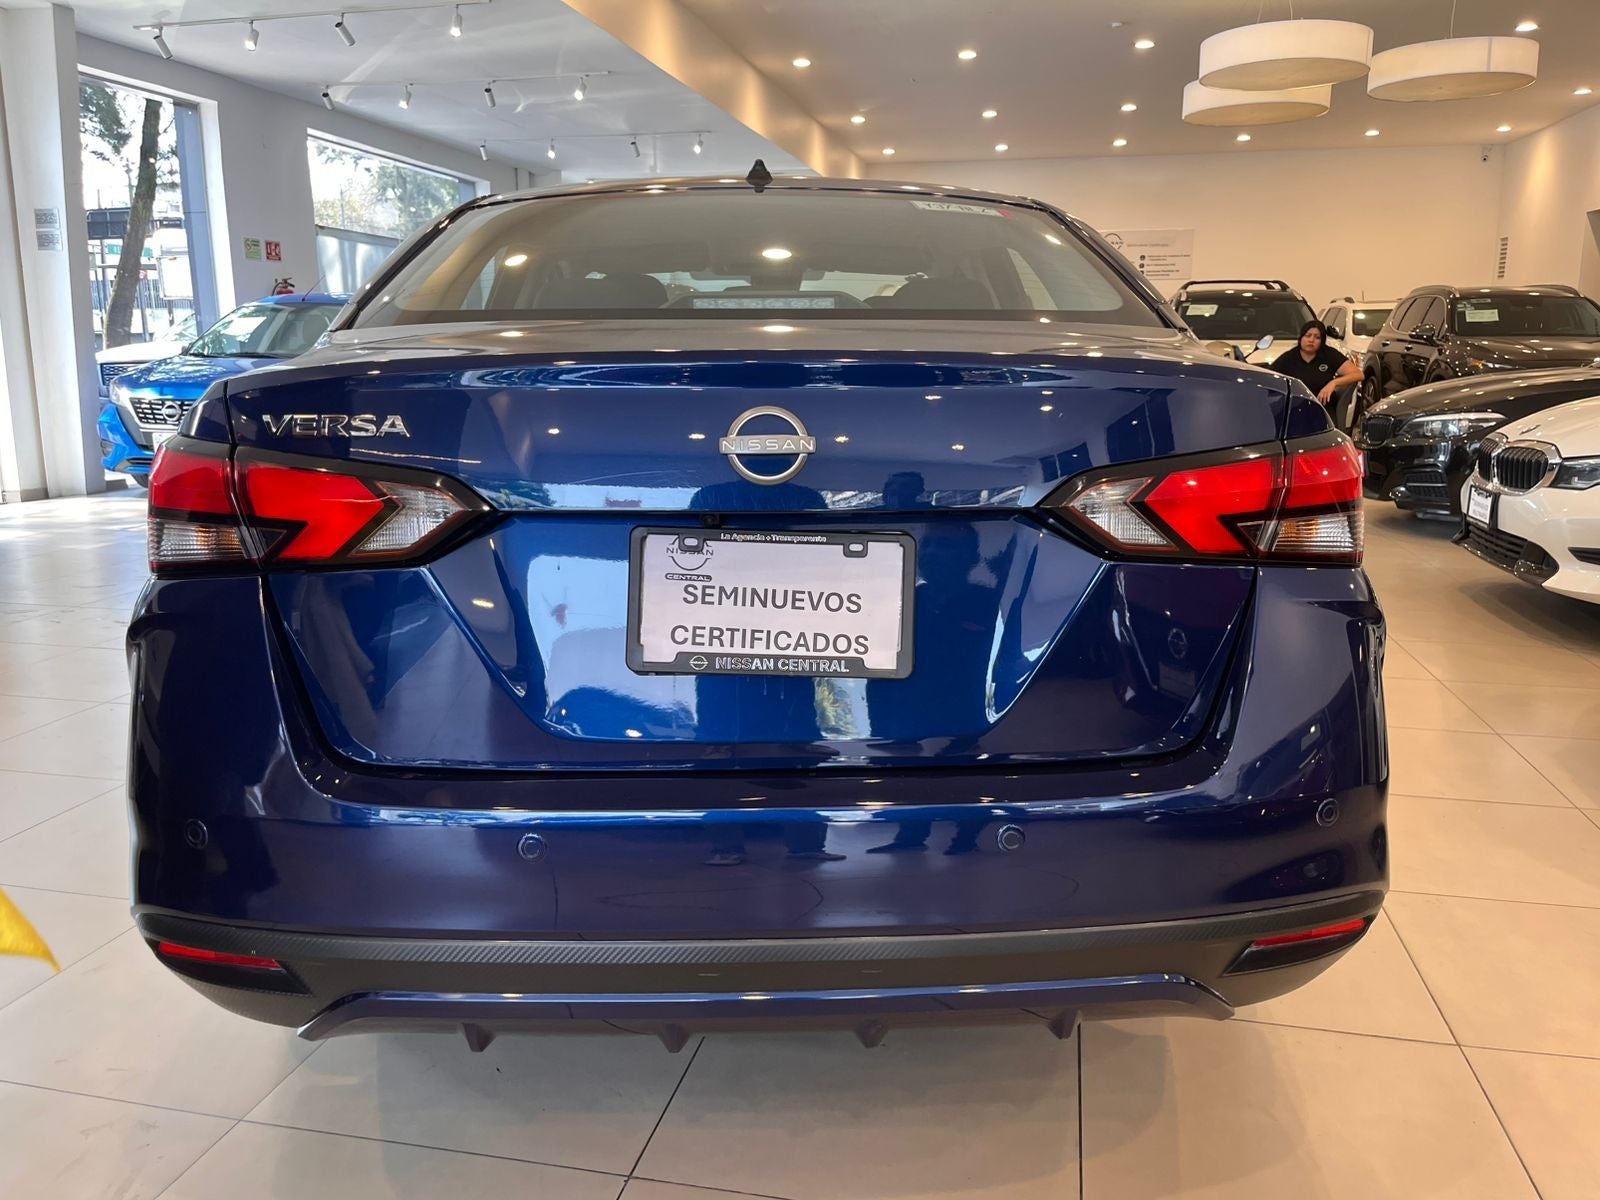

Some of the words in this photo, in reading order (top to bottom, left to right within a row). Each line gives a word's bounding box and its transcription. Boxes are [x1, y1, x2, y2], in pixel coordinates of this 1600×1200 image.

[262, 414, 411, 438] VERSA
[722, 439, 814, 451] NISSAN
[666, 574, 711, 582] CENTRAL
[683, 584, 862, 614] SEMINUEVOS
[670, 625, 869, 656] CERTIFICADOS
[715, 656, 774, 671] NISSAN
[778, 658, 850, 673] CENTRAL
